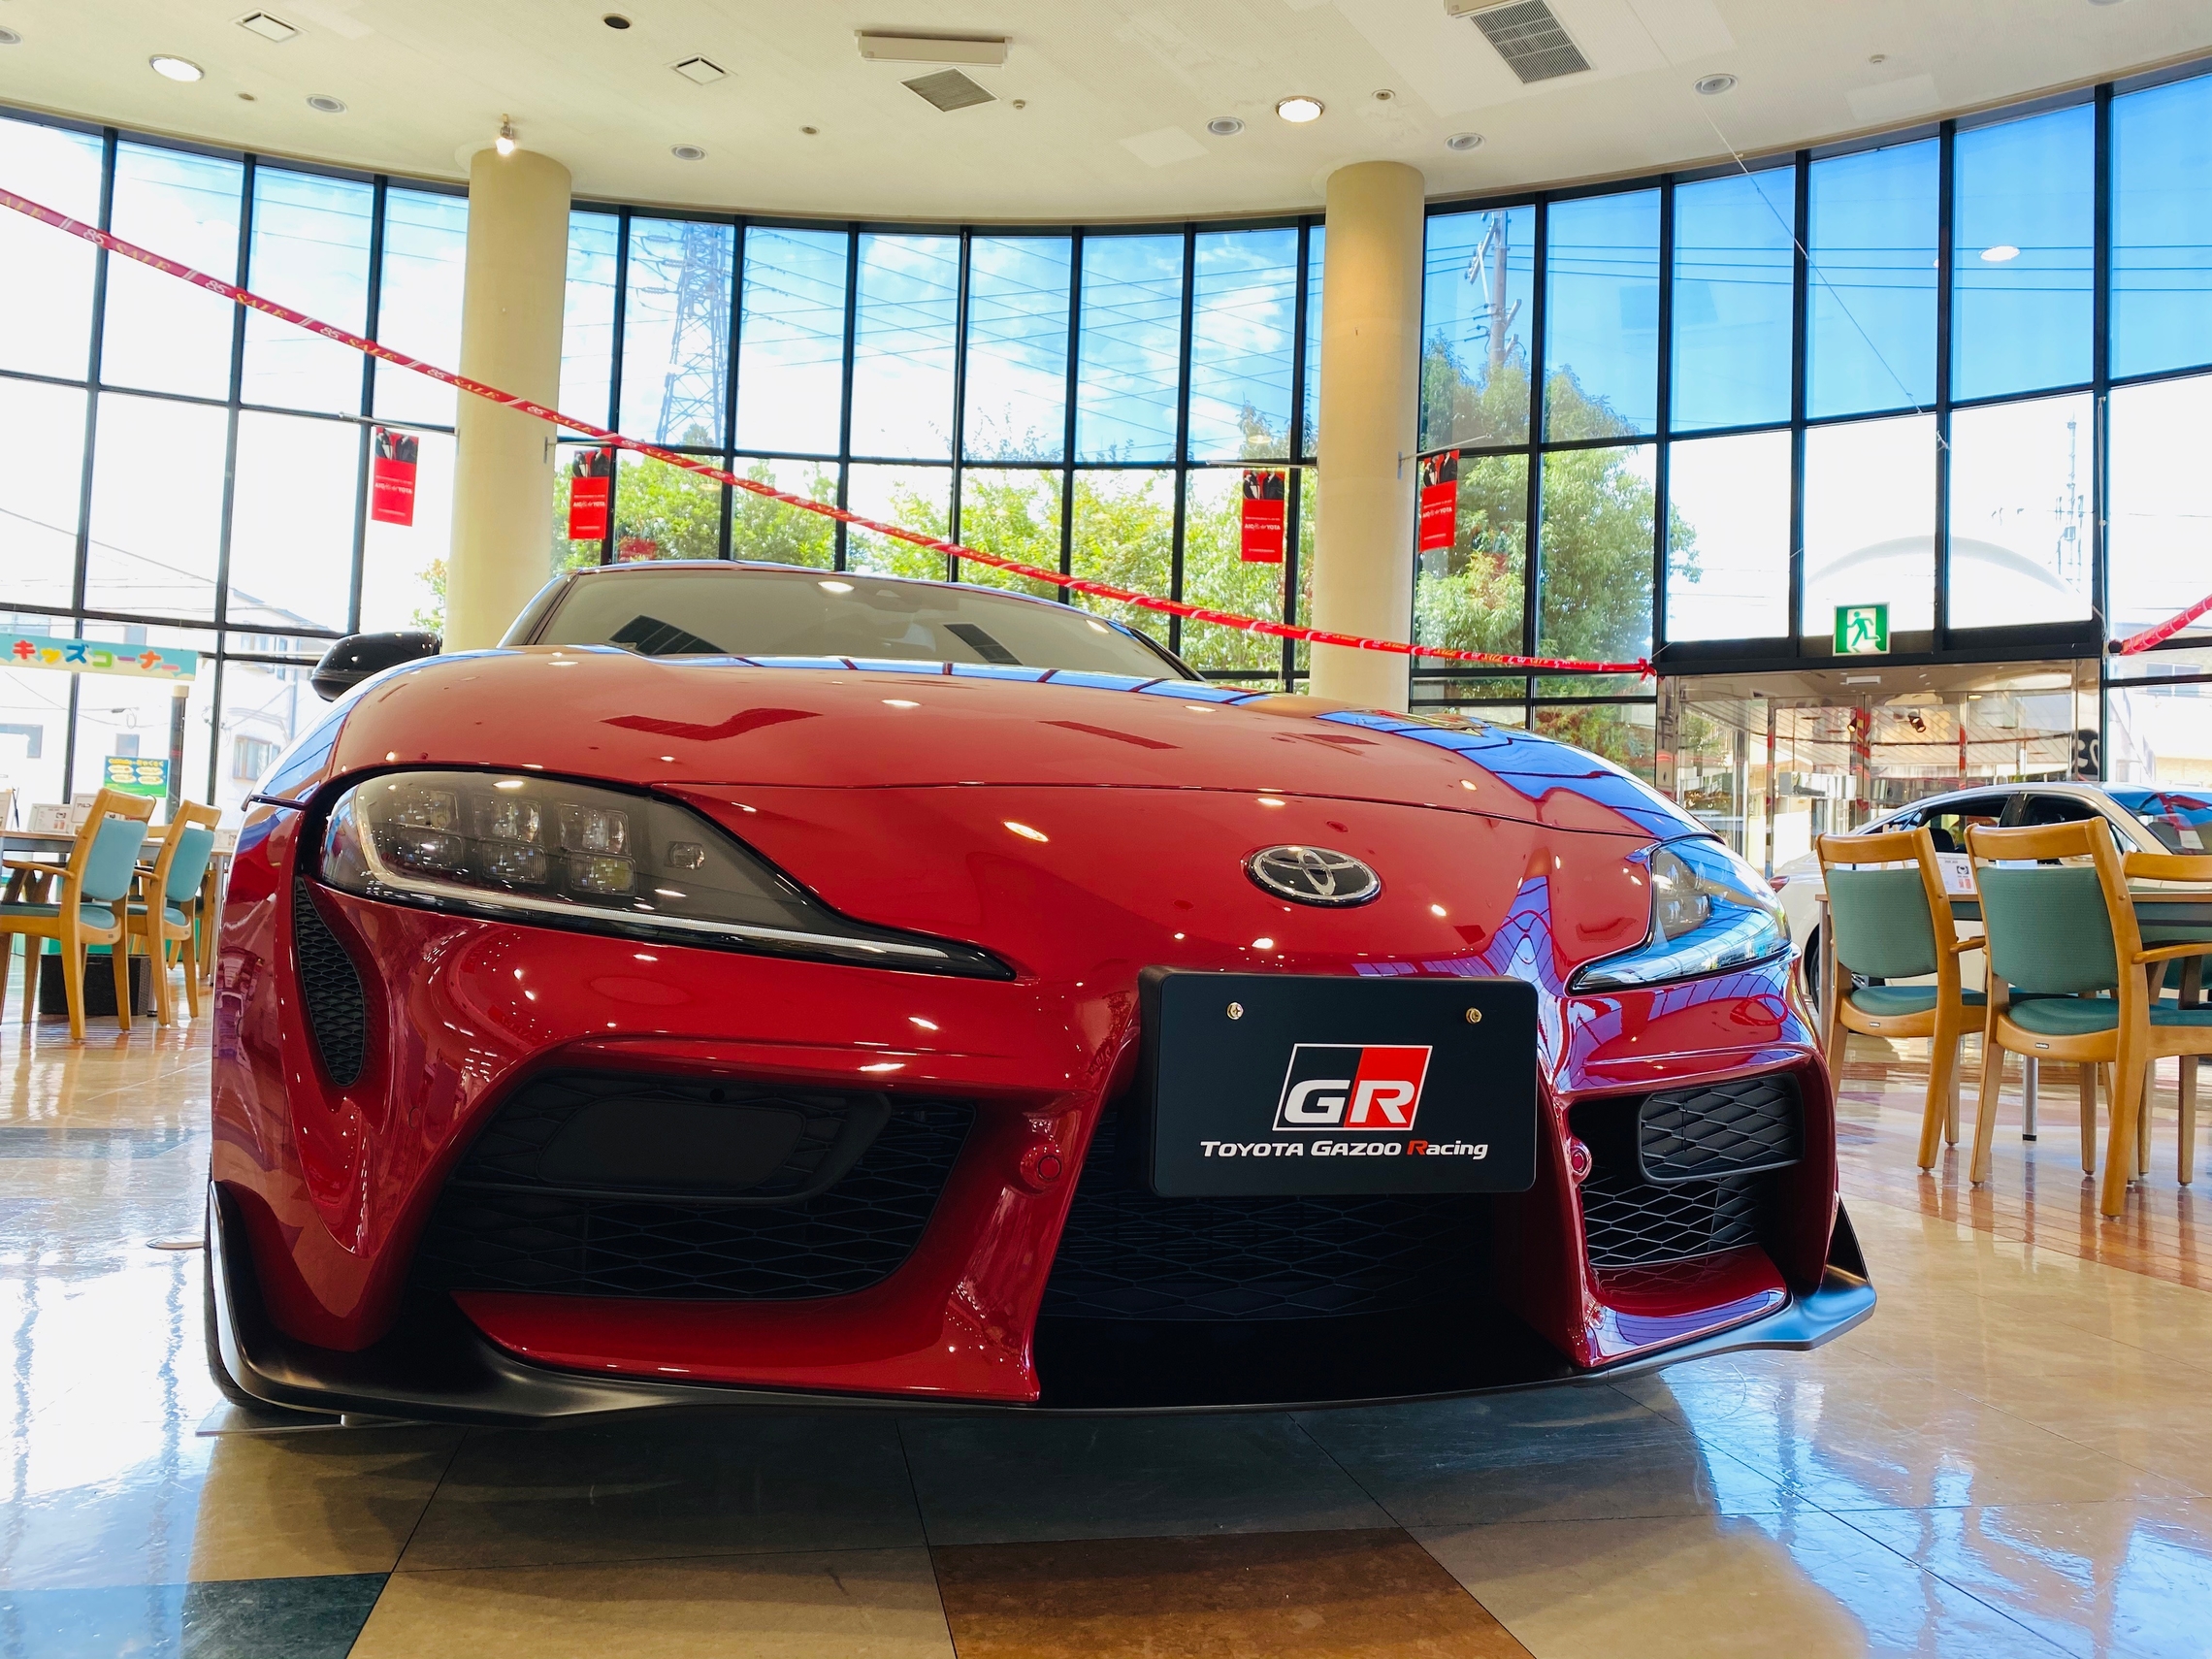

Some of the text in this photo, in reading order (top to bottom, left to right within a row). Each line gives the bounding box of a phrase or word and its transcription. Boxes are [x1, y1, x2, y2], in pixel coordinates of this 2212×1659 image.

[13, 639, 179, 670] キッズコーナー
[1284, 1079, 1415, 1123] GR
[1200, 1140, 1488, 1160] TOYOTA GAZOO Racing
